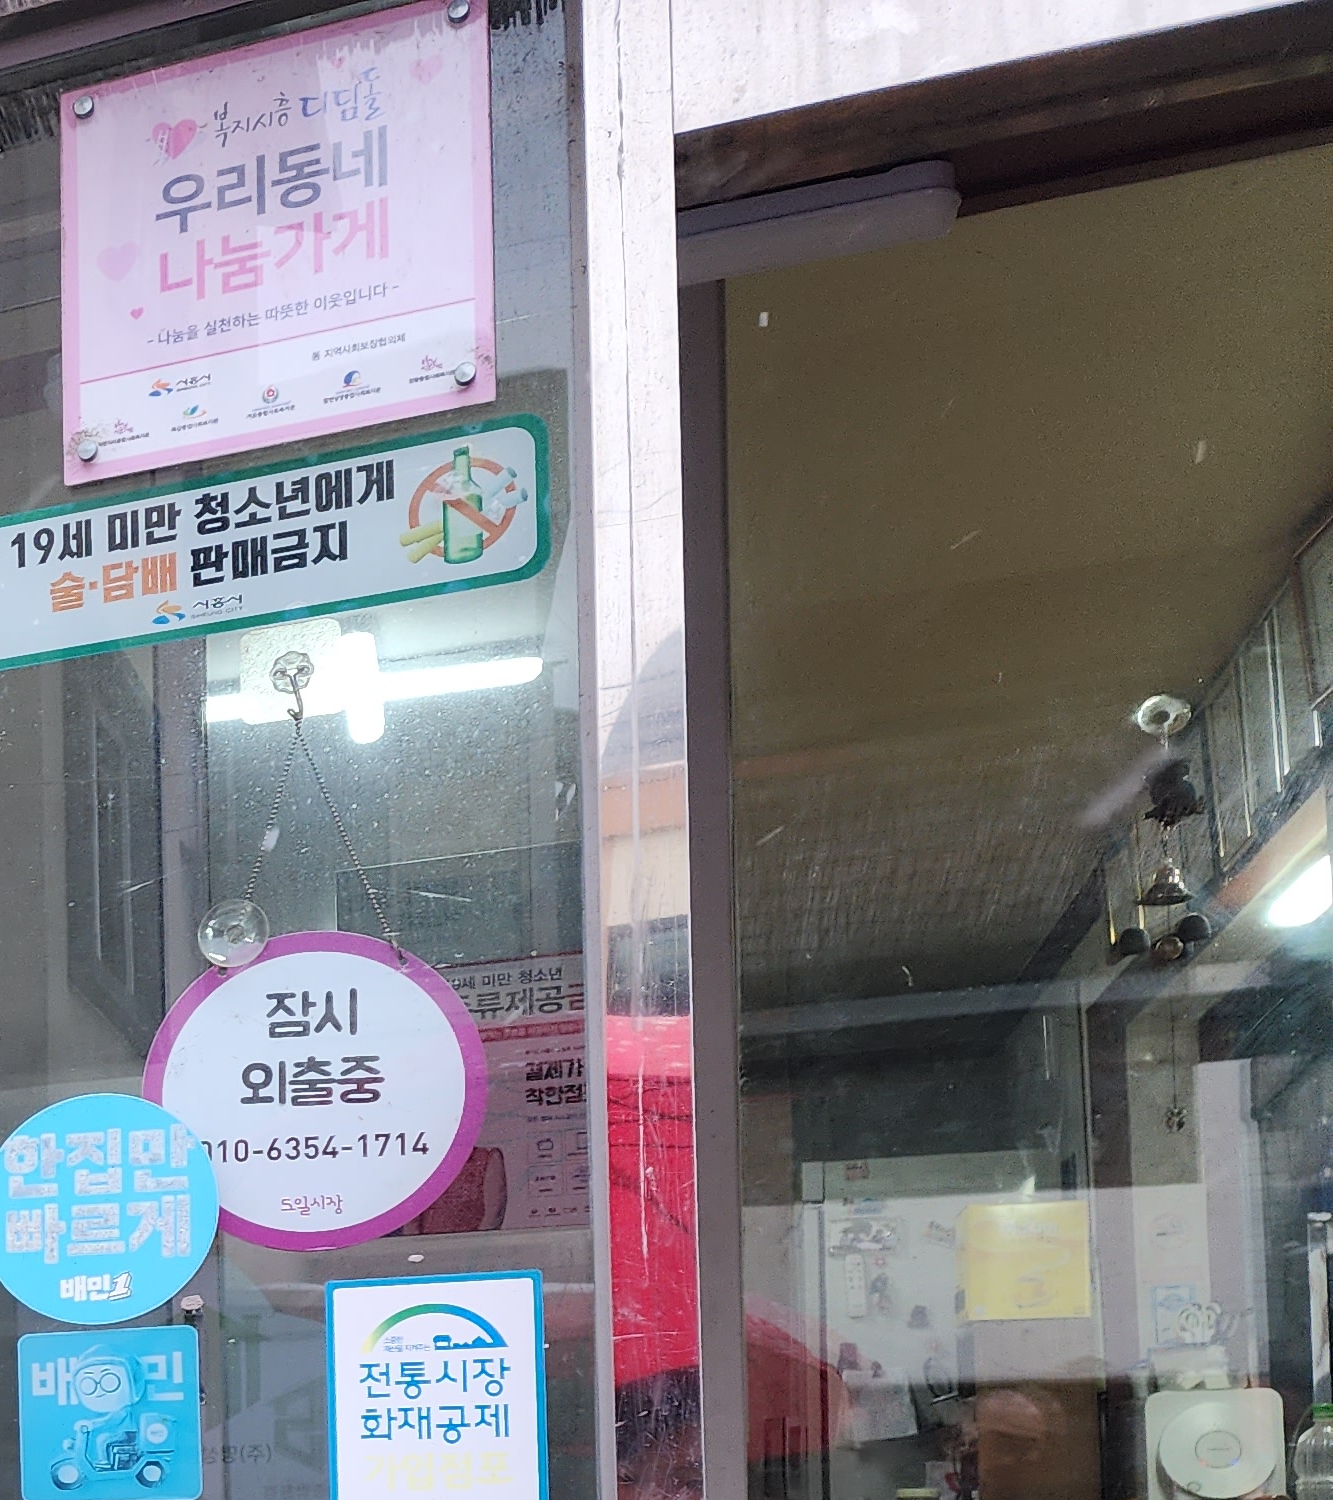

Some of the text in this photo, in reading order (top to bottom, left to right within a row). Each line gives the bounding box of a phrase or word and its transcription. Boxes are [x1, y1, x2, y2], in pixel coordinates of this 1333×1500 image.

[214, 66, 388, 148] 복지시흥 디딤돌
[155, 124, 390, 234] 우리동네
[159, 196, 390, 300] 나눔가게
[157, 323, 200, 347] 나눔을
[204, 312, 261, 338] 실천하는
[265, 299, 310, 322] 따뜻한
[314, 282, 388, 313] 이웃입니다
[10, 459, 397, 570] 19세 미만 청소년에게
[49, 521, 351, 613] 술·담배 판매금지
[483, 972, 511, 988] 미만
[517, 967, 563, 984] 청소년
[265, 987, 358, 1039] 잠시
[239, 1055, 386, 1107] 외출중
[3, 1122, 198, 1199] 한집만
[4, 1193, 192, 1266] 빠르게
[280, 1194, 344, 1216] 도일시장
[59, 1270, 132, 1302] 배민1
[359, 1357, 512, 1400] 전통시장
[360, 1403, 510, 1444] 화재공제
[364, 1451, 515, 1492] 가입점포
